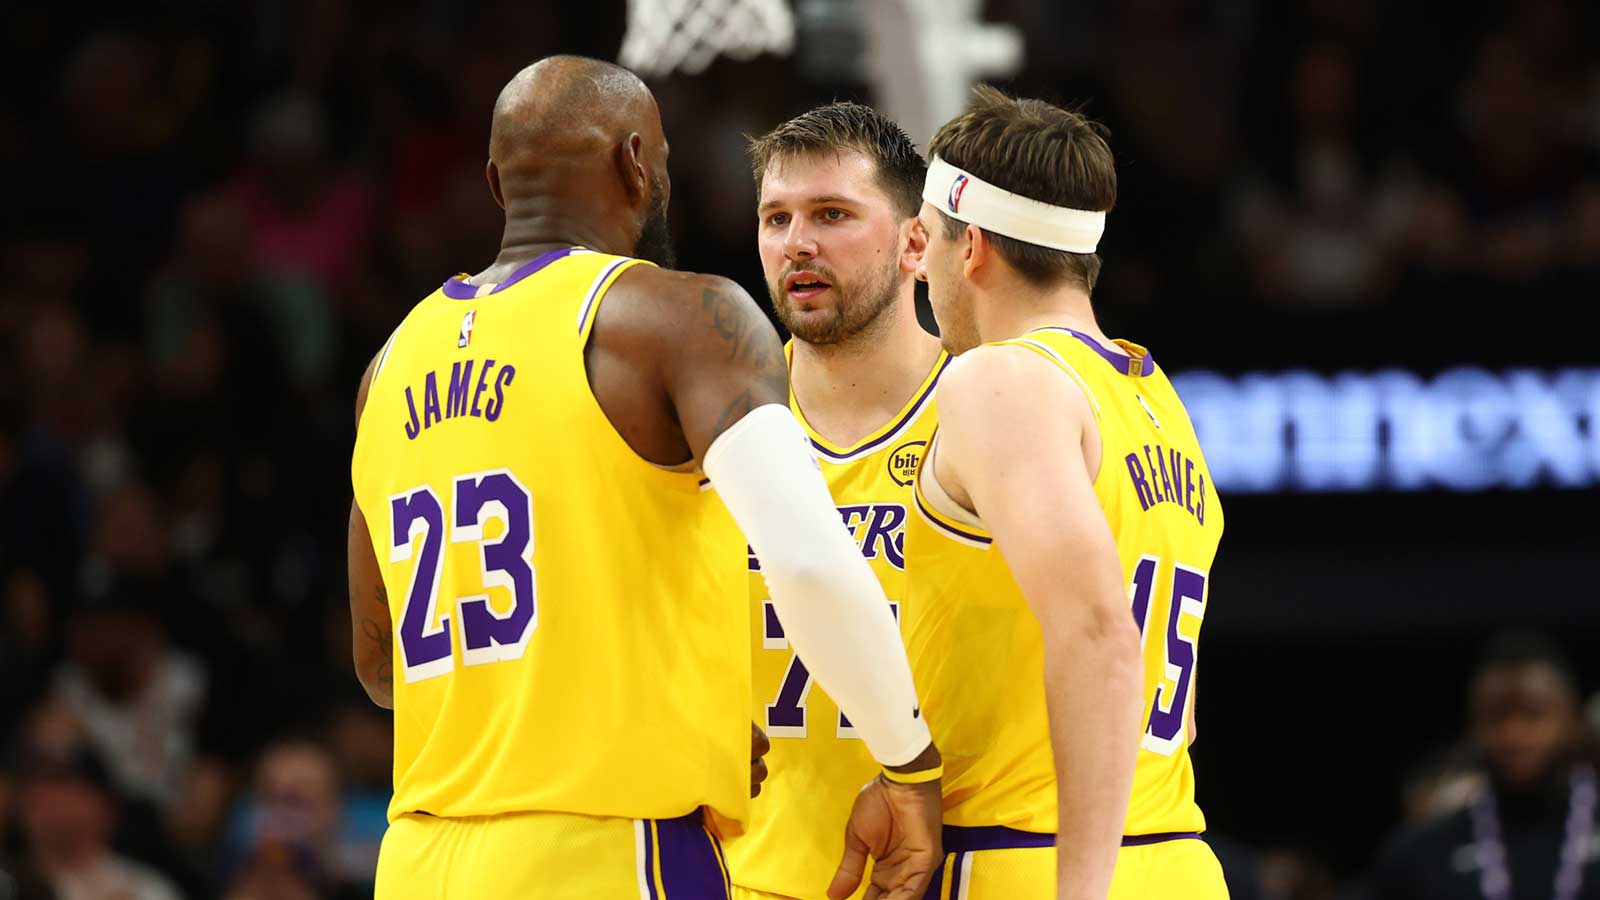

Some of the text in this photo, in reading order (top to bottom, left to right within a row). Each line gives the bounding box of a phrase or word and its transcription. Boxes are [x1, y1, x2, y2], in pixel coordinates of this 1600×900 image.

[404, 359, 516, 440] JAMES
[894, 453, 919, 469] bib
[1125, 444, 1206, 527] REAVES
[389, 468, 538, 684] 23
[1129, 553, 1209, 757] 15
